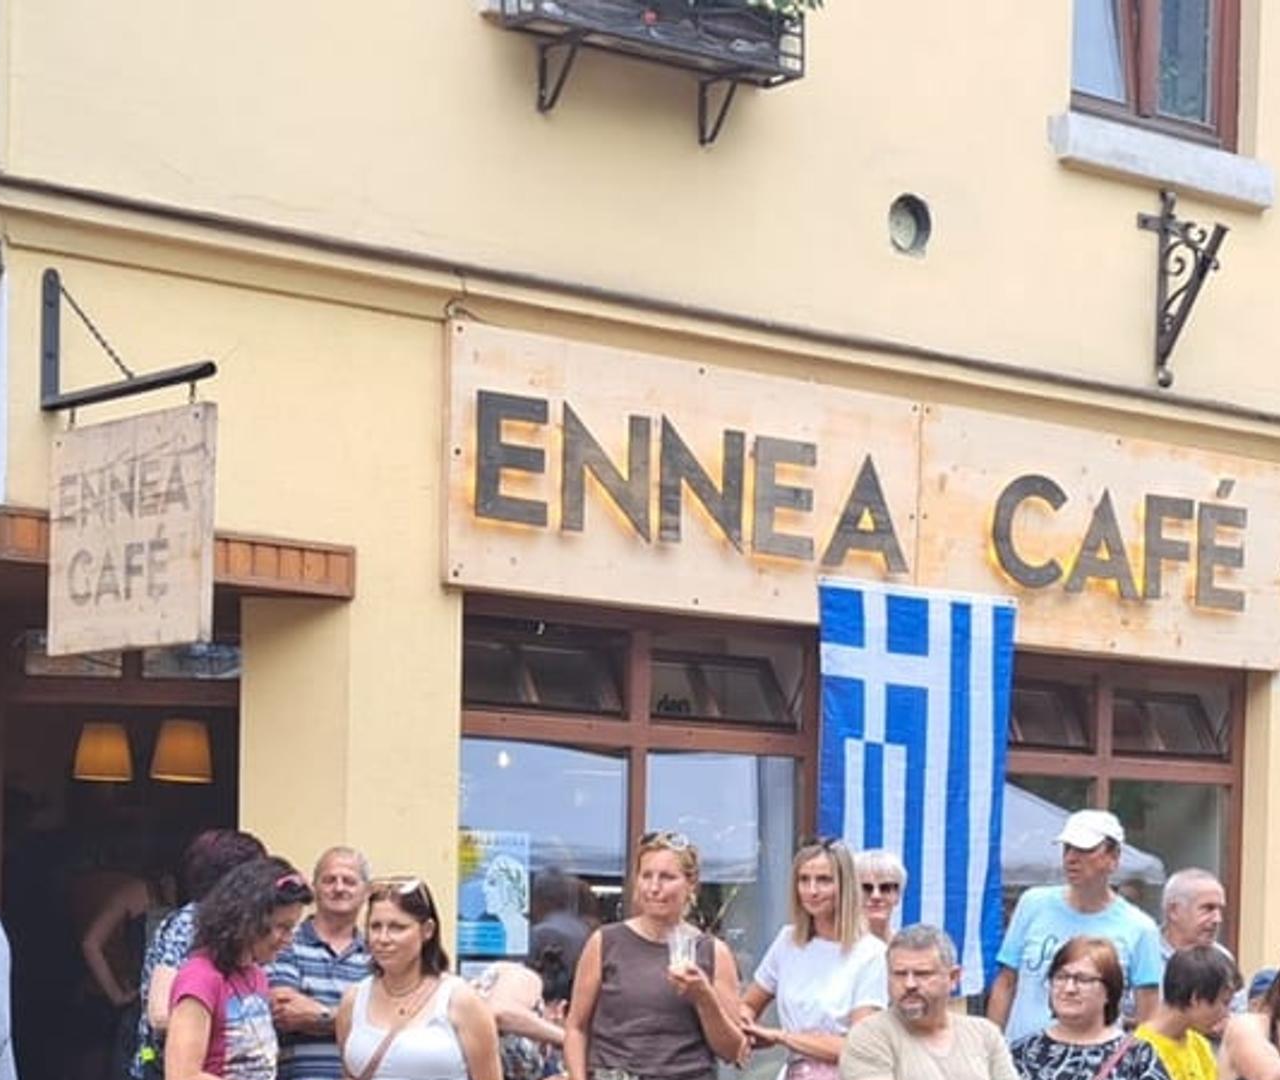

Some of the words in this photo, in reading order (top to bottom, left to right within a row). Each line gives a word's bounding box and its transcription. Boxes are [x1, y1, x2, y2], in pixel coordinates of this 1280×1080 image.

[58, 456, 189, 529] ENNEA
[475, 390, 910, 574] ENNEA
[992, 473, 1248, 612] CAFÉ
[68, 522, 170, 606] CAFÉ
